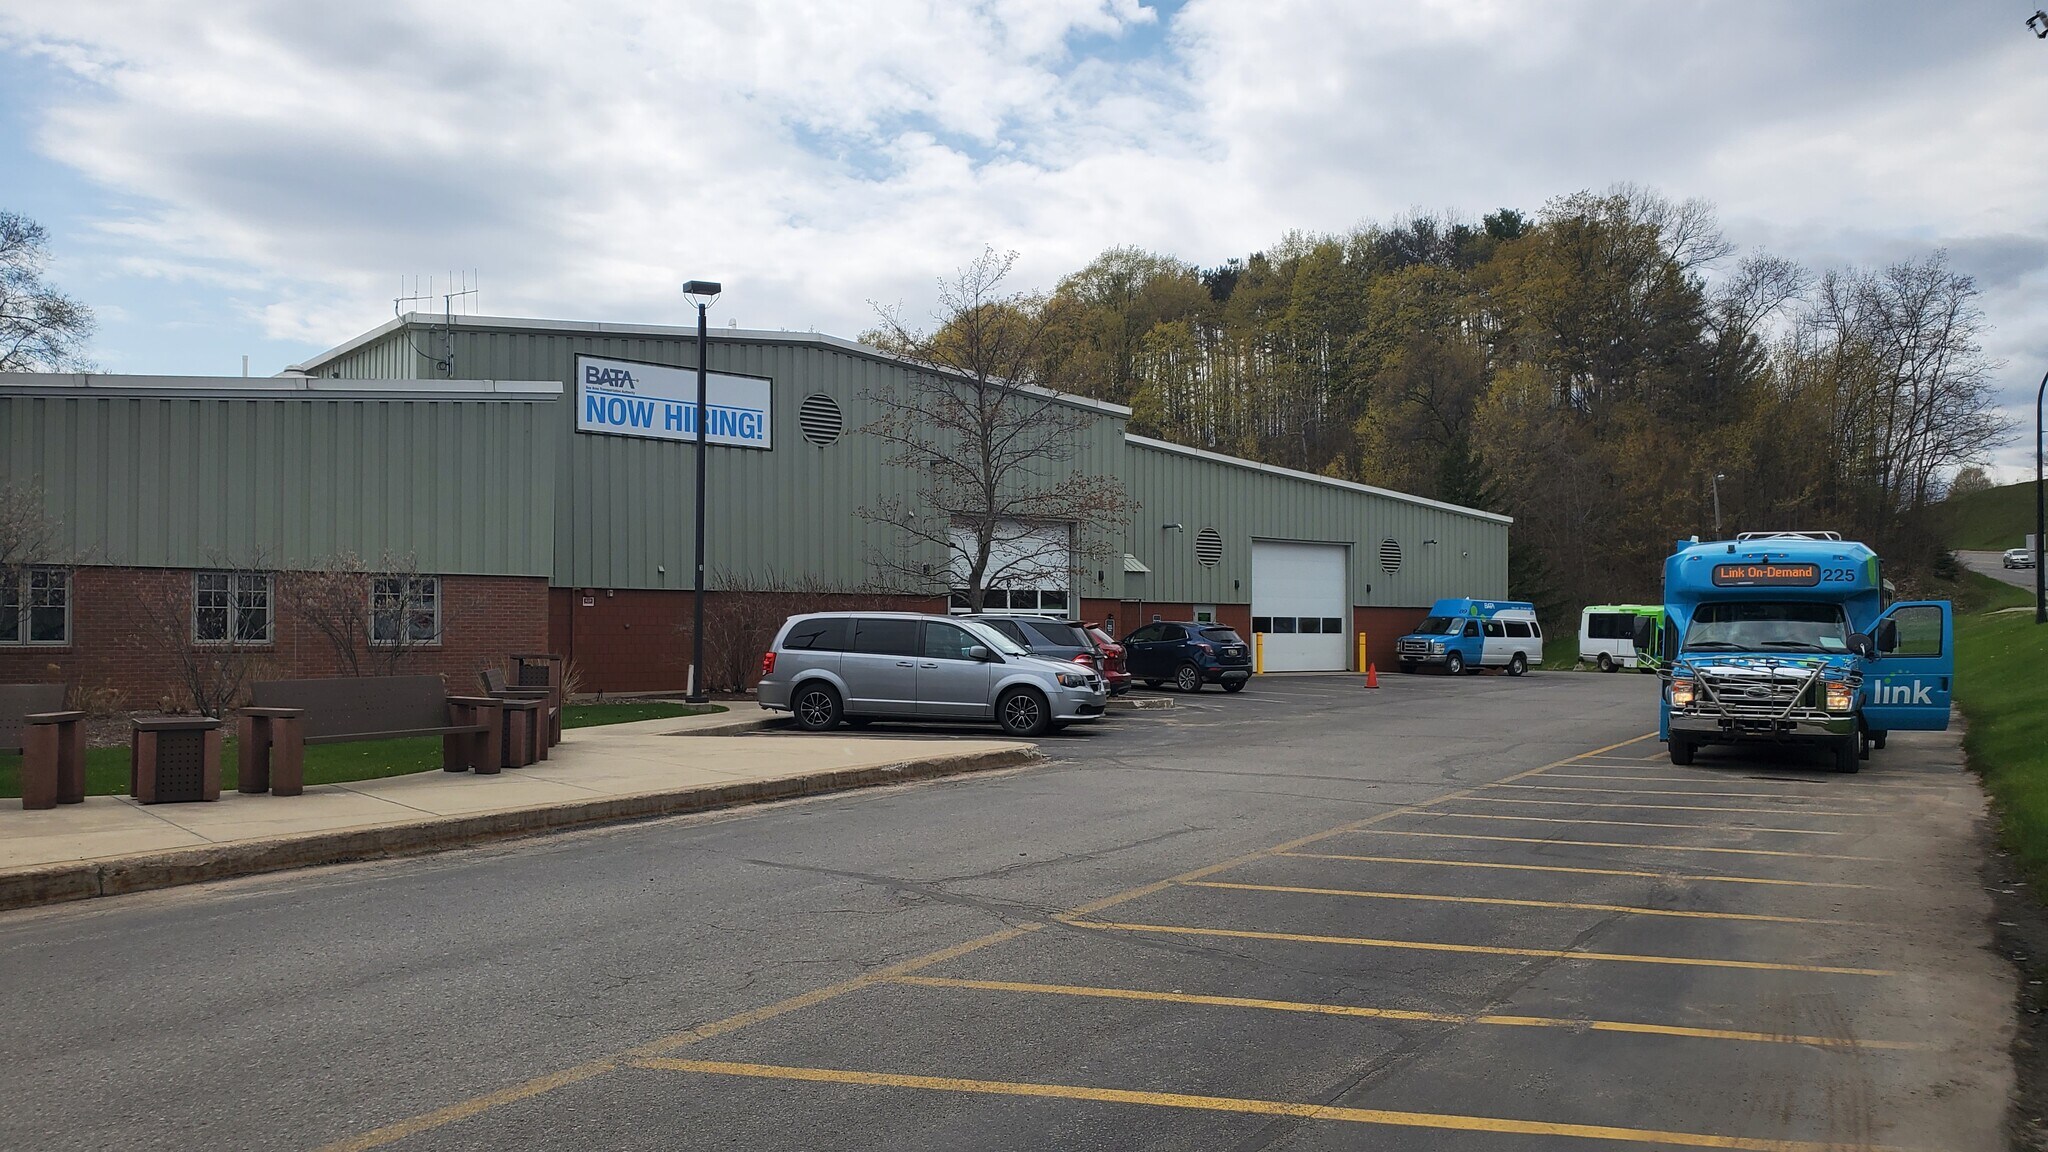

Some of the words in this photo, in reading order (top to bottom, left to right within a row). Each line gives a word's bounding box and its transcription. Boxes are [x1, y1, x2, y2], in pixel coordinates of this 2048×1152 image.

[586, 366, 635, 389] BATA
[586, 395, 655, 428] NOW
[1720, 567, 1745, 578] Link
[1747, 566, 1812, 578] On-Demand
[1822, 569, 1855, 582] 225
[1874, 677, 1932, 704] link
